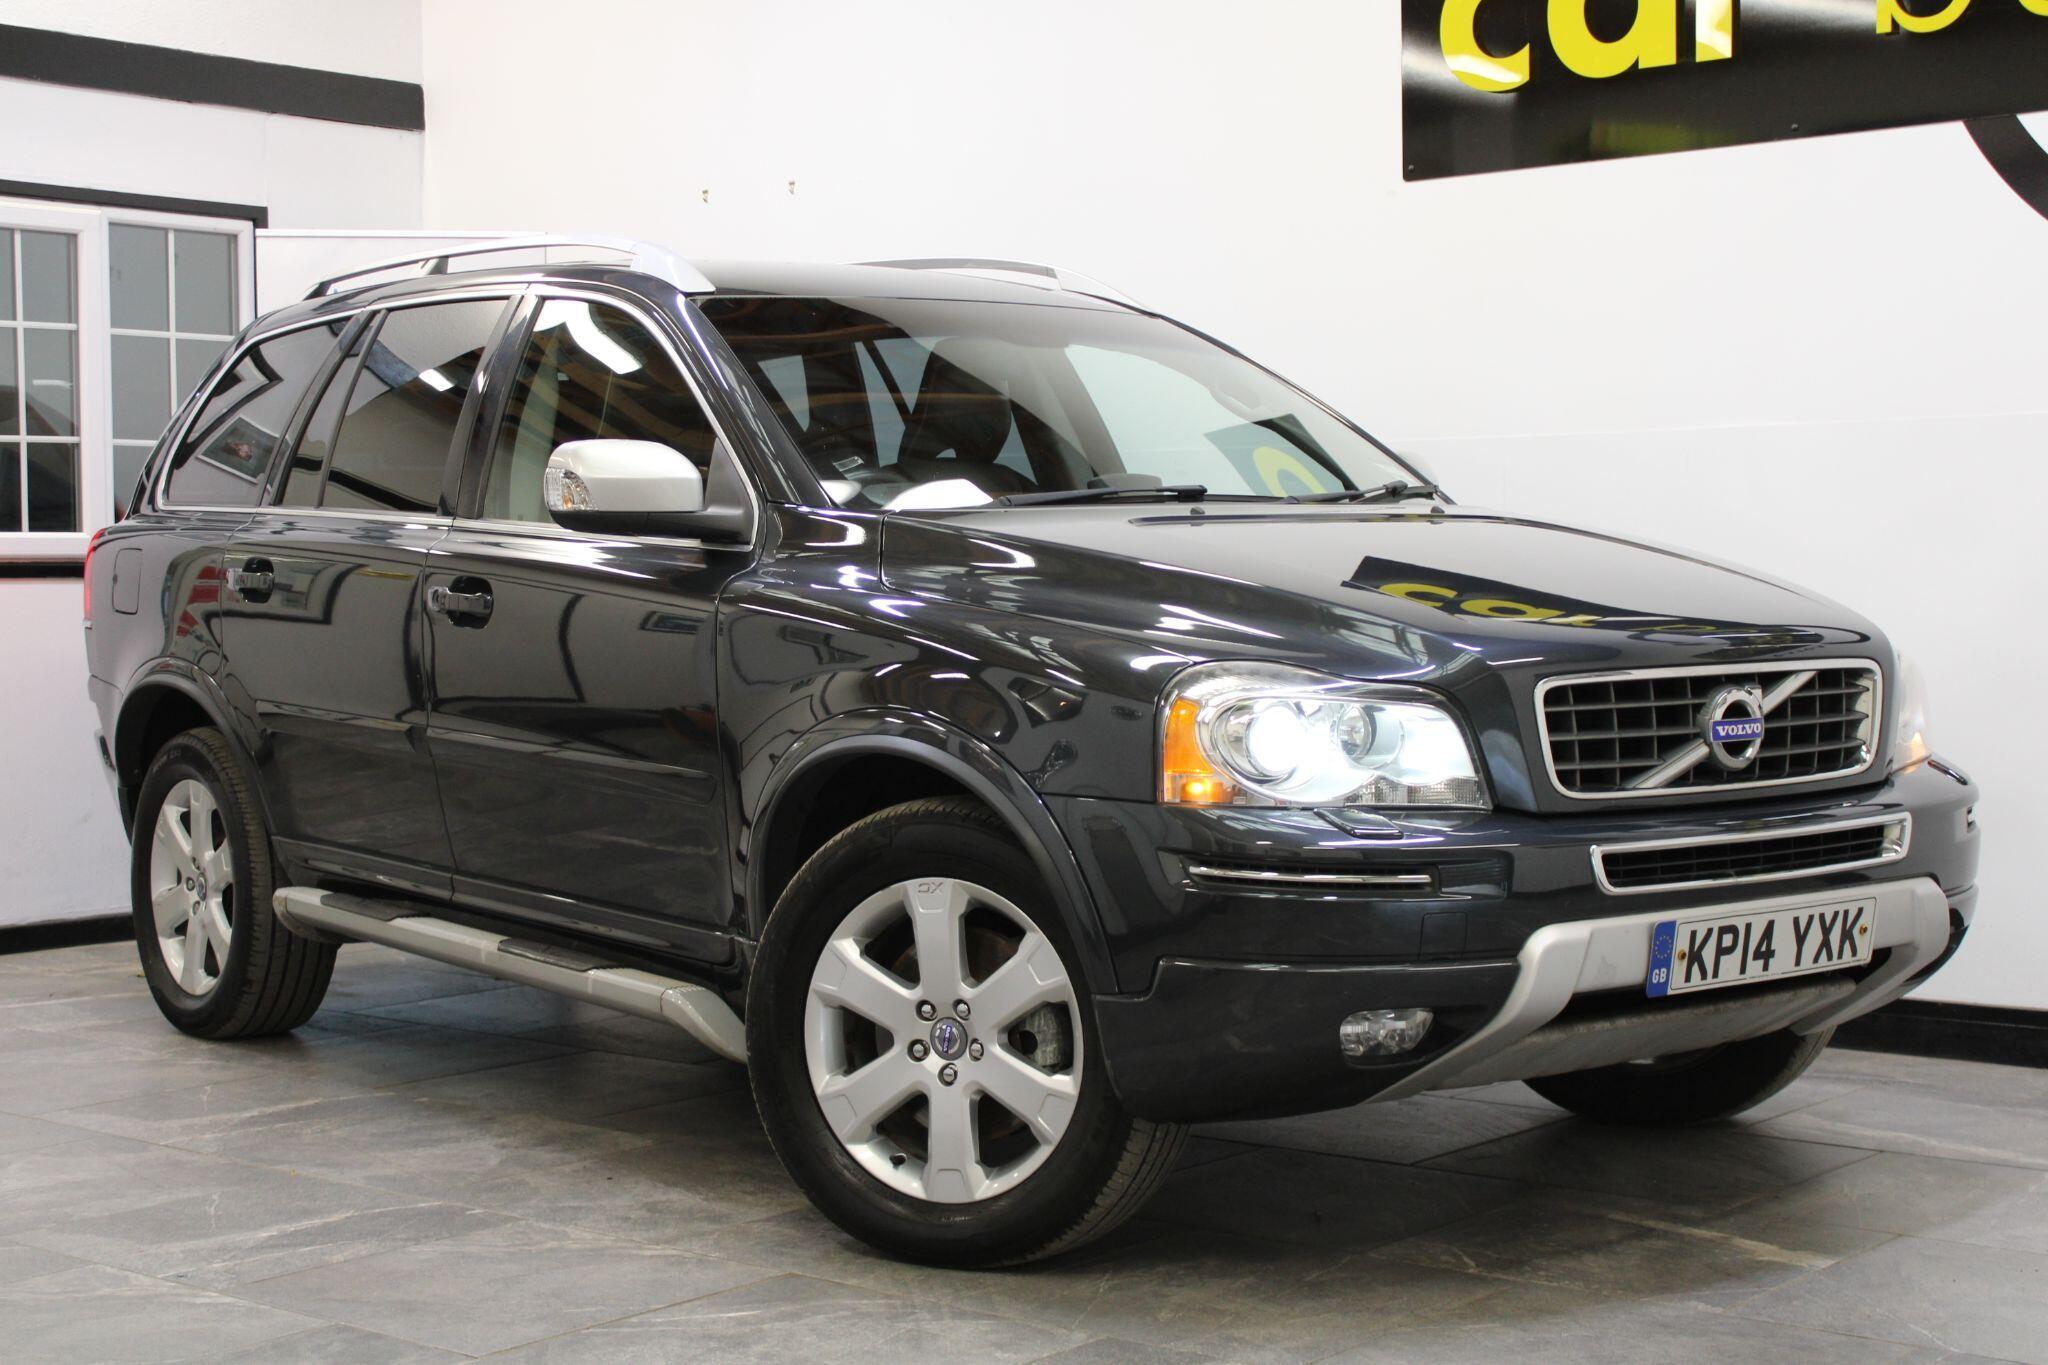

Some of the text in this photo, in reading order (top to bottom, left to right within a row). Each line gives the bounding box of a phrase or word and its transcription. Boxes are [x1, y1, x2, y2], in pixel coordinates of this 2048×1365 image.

[1716, 723, 1761, 736] VOLVO
[1684, 907, 1864, 983] KP14 YXK
[1652, 968, 1667, 983] GB
